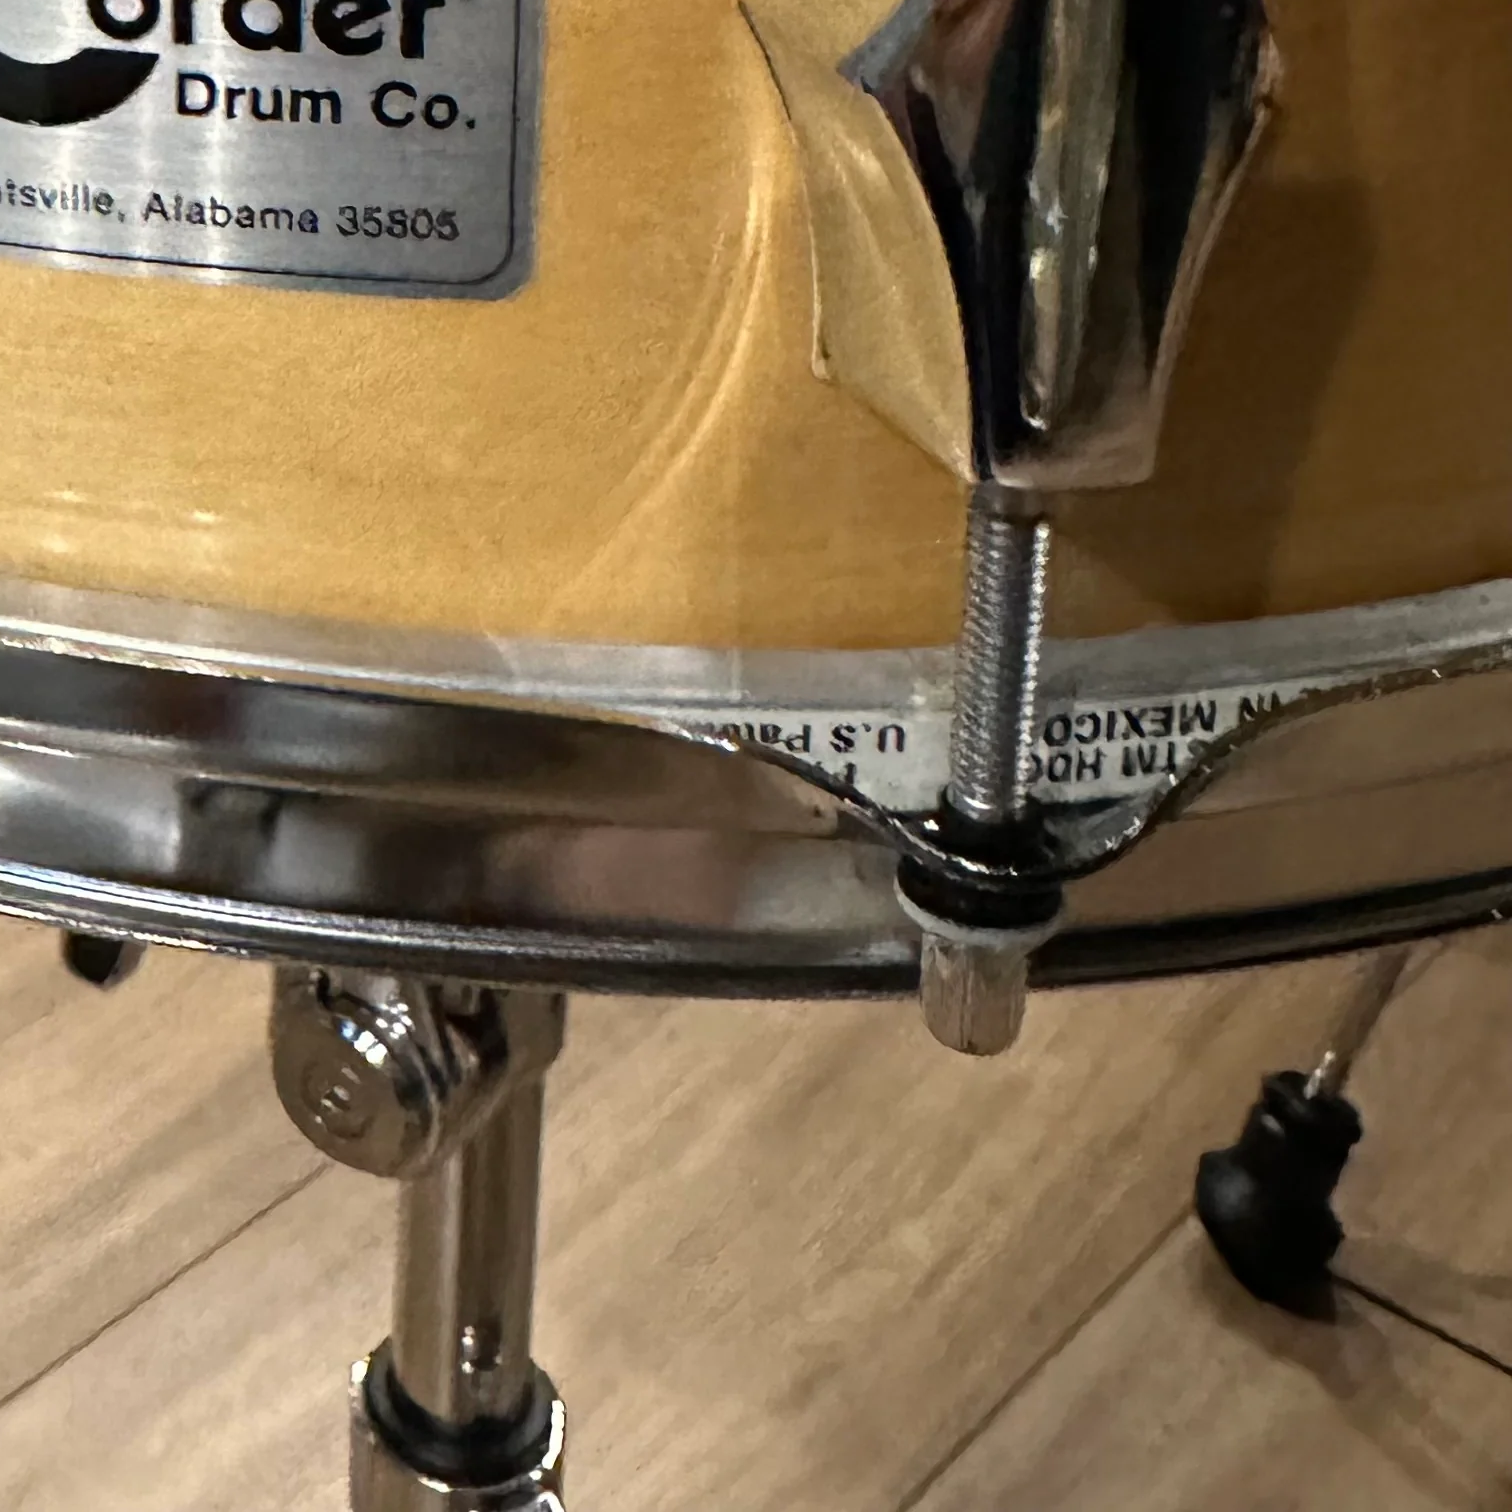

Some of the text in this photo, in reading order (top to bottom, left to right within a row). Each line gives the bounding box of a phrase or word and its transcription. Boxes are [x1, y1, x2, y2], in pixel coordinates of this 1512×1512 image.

[176, 71, 478, 130] Drum Co.
[142, 189, 320, 235] Alabama
[335, 204, 461, 243] 35805
[1042, 699, 1217, 747] MEXICO
